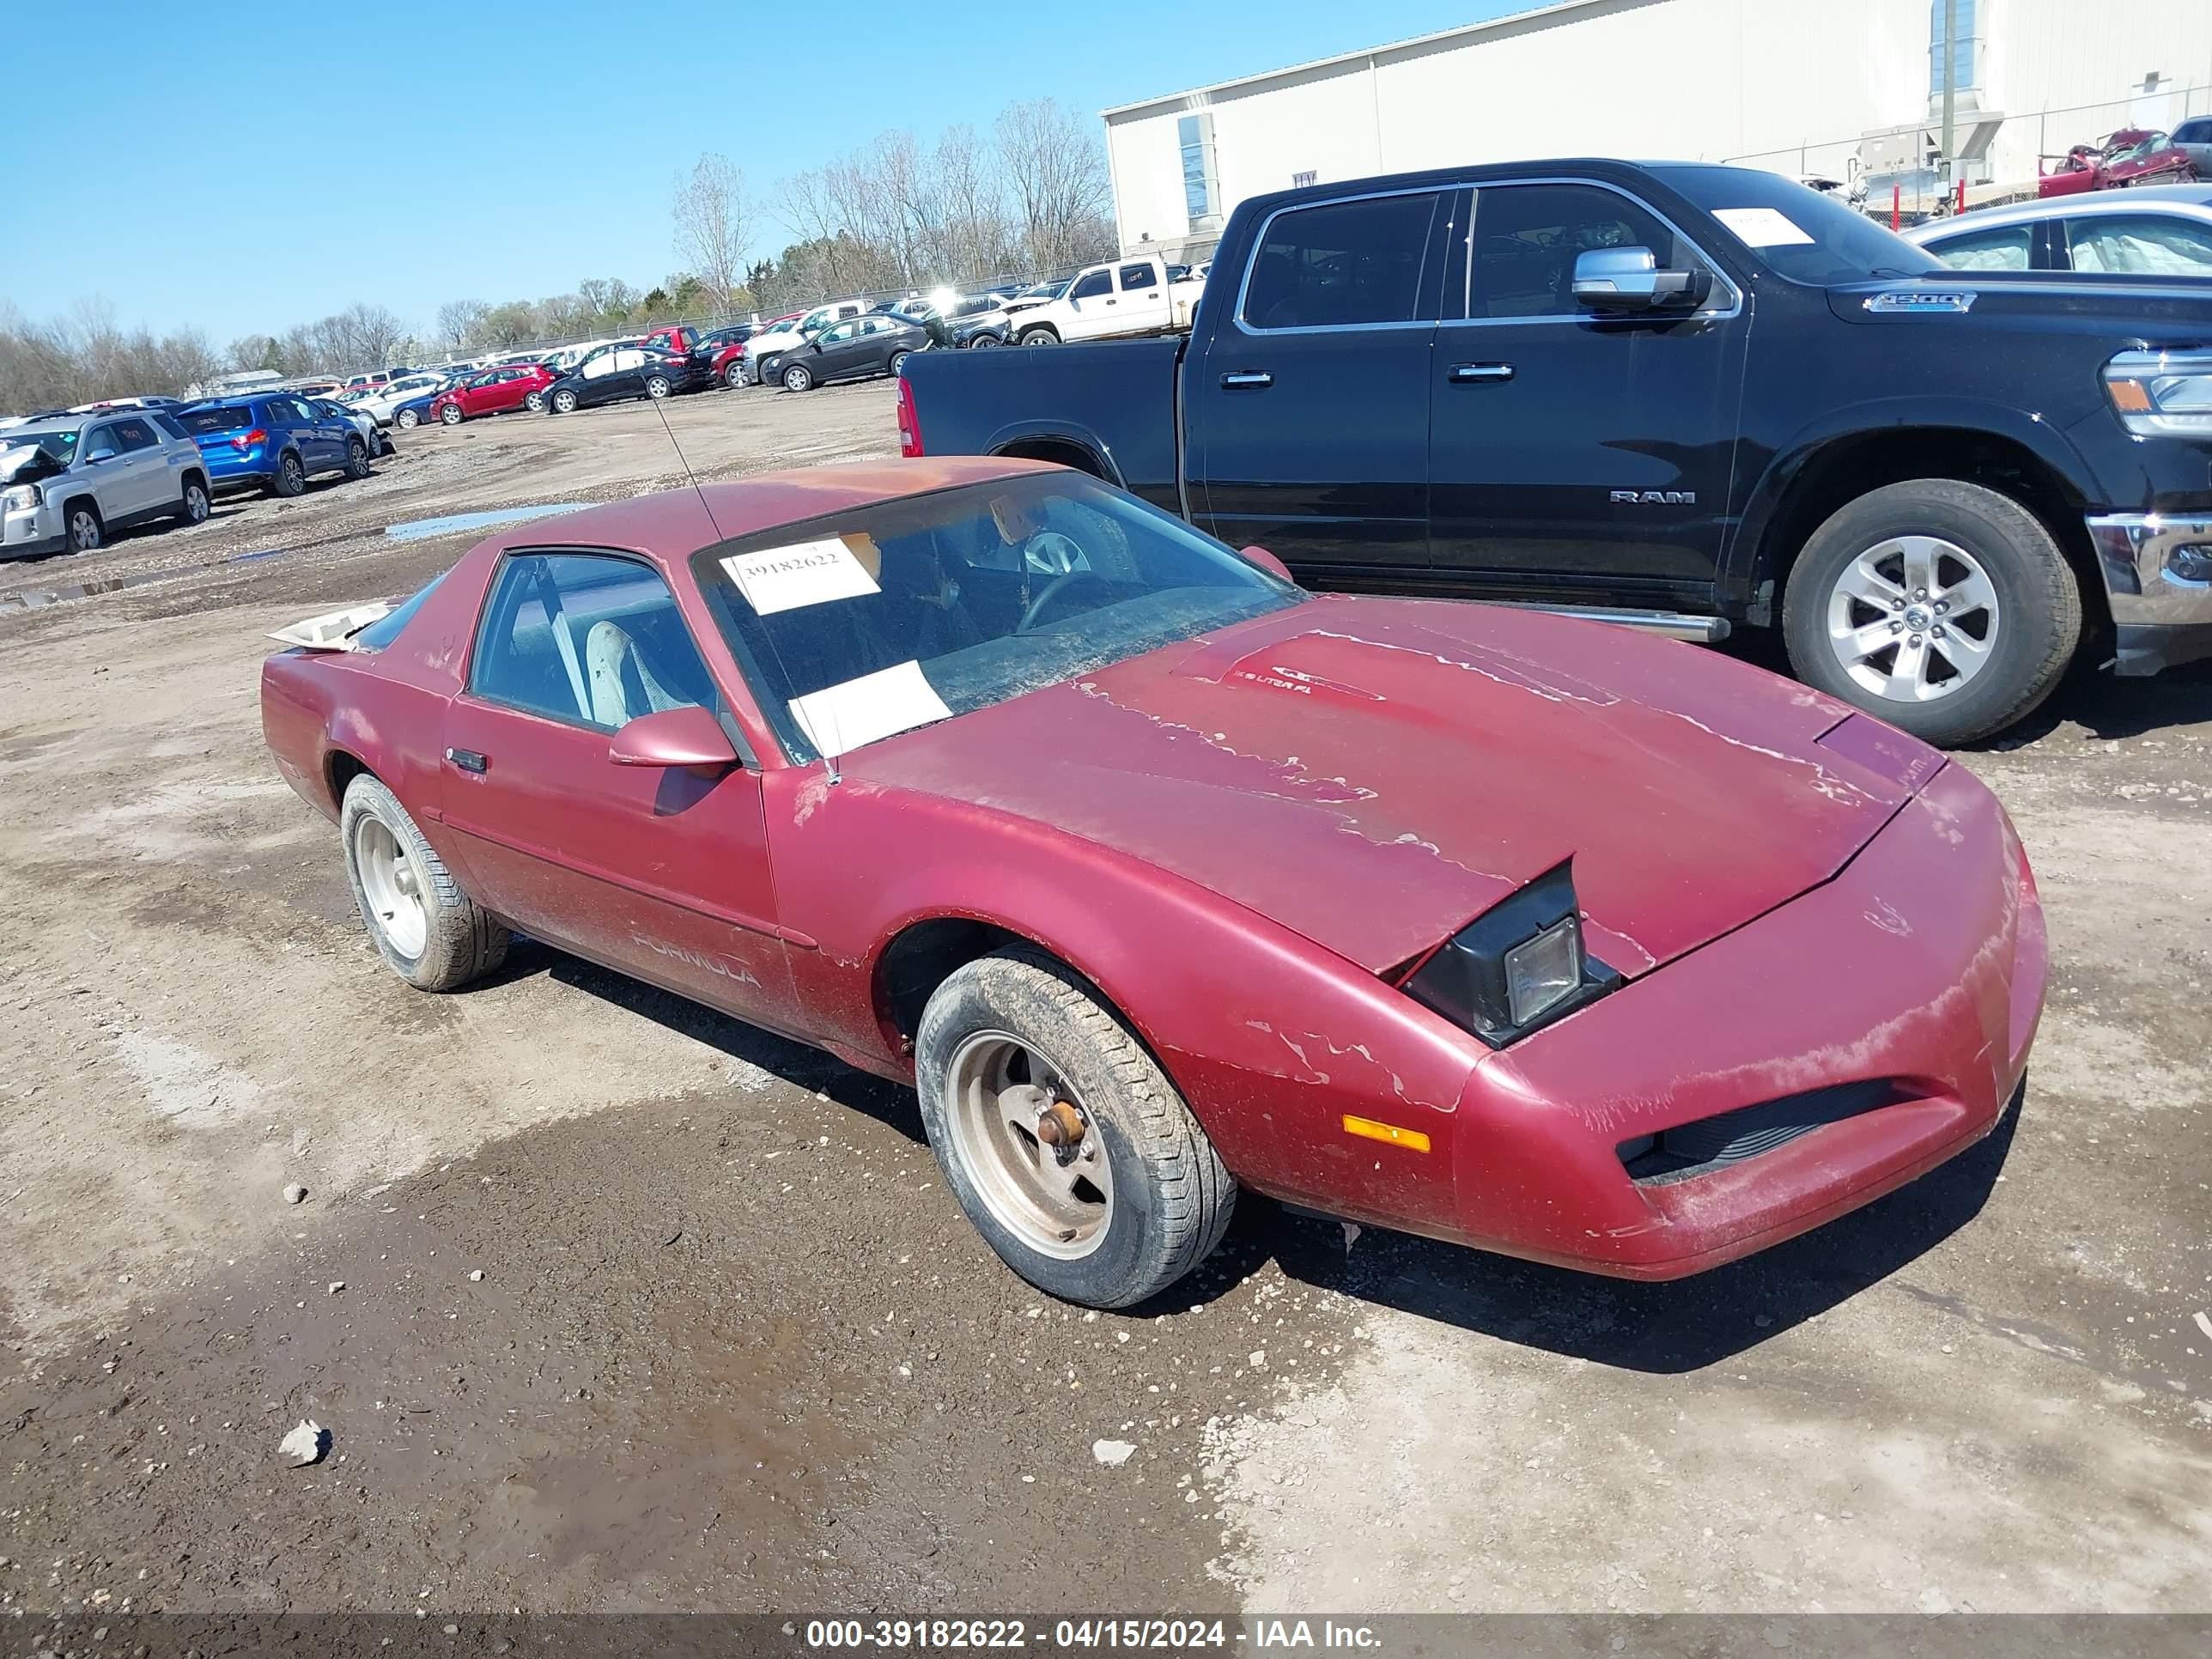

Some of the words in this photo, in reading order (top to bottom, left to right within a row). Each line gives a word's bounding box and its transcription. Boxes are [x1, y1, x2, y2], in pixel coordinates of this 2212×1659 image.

[1887, 295, 1960, 304] 1500
[1610, 490, 1695, 504] RAM
[744, 552, 841, 580] 39182622
[632, 934, 763, 989] FORMULA
